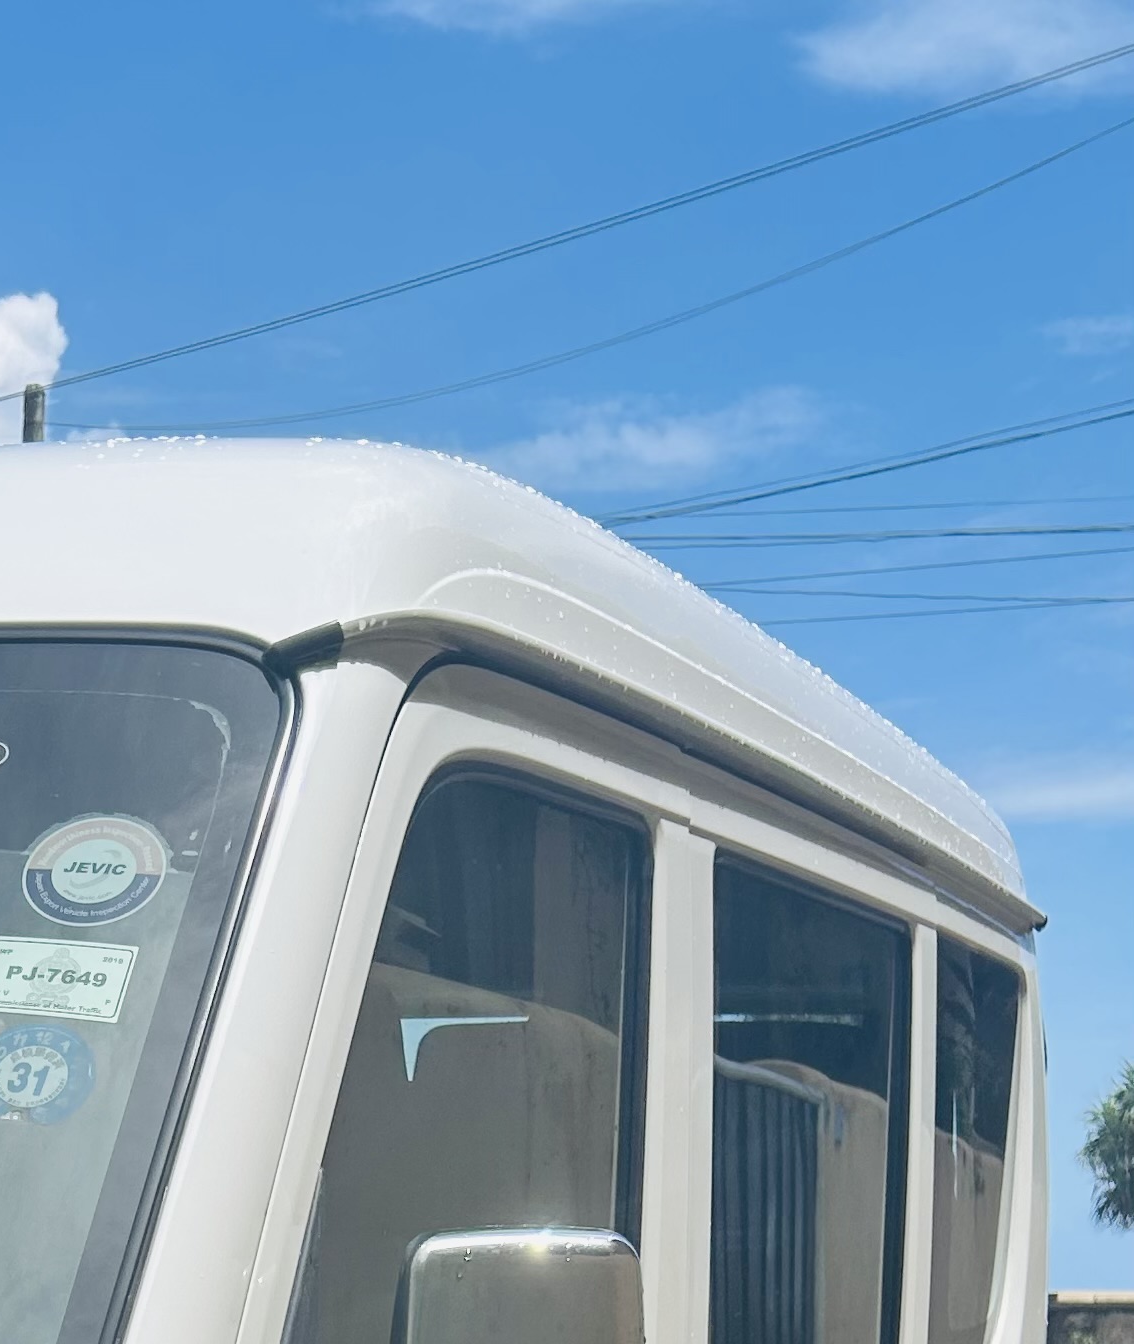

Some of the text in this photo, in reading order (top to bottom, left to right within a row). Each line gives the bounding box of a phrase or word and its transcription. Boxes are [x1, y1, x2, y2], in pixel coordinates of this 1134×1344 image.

[63, 861, 127, 876] JEVIC
[40, 890, 60, 911] Export
[130, 876, 149, 900] Center
[6, 964, 108, 988] PJ-7649
[36, 1031, 54, 1046] 12
[7, 1062, 51, 1097] 31
